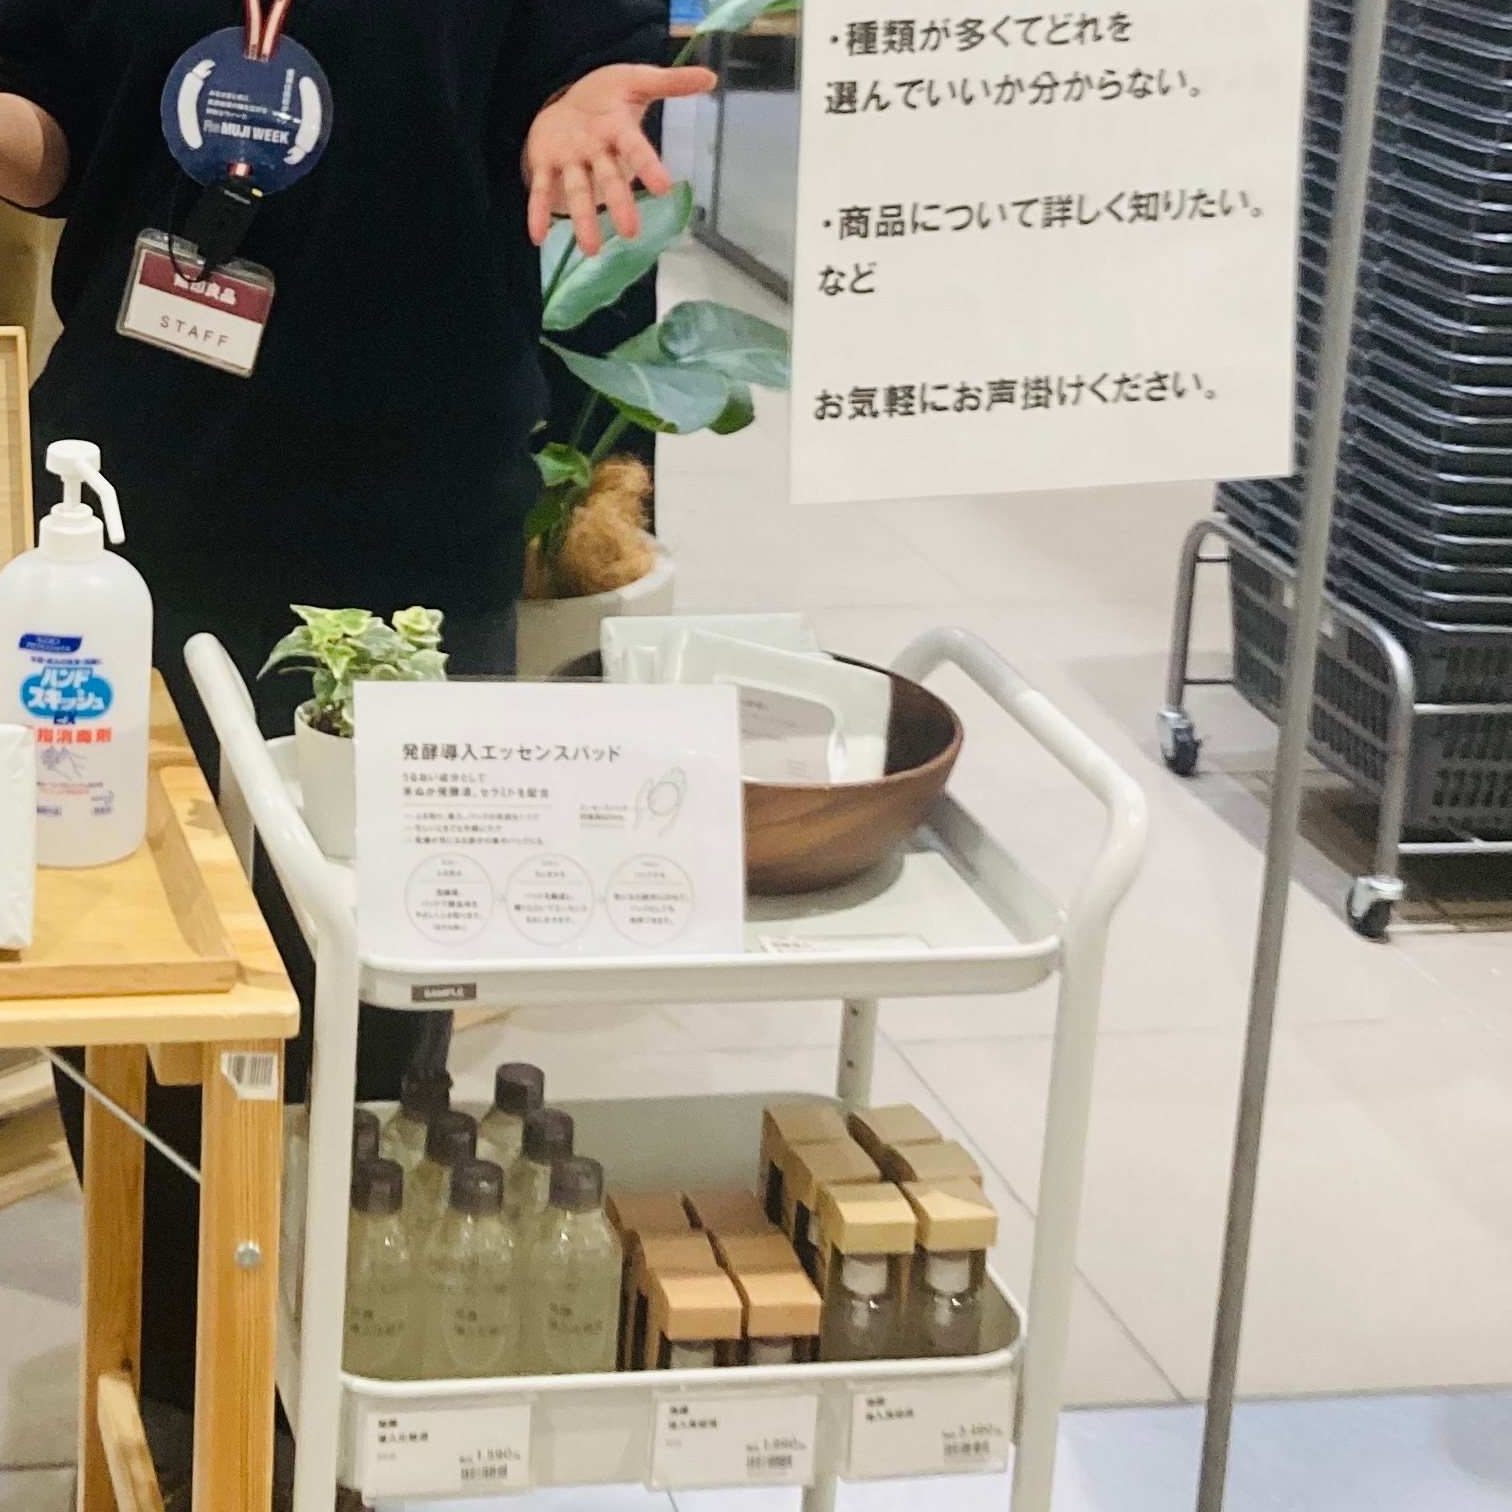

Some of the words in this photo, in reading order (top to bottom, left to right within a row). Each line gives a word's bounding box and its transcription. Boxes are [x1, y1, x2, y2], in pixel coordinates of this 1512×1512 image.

[824, 67, 1203, 115] 選んでいいか分からない。
[221, 121, 251, 139] MUJI
[252, 126, 290, 144] WEEK
[816, 260, 879, 296] など
[160, 315, 230, 346] STAFF
[813, 369, 1217, 421] お気軽にお声掛けください。
[36, 727, 112, 744] 指消毒剤
